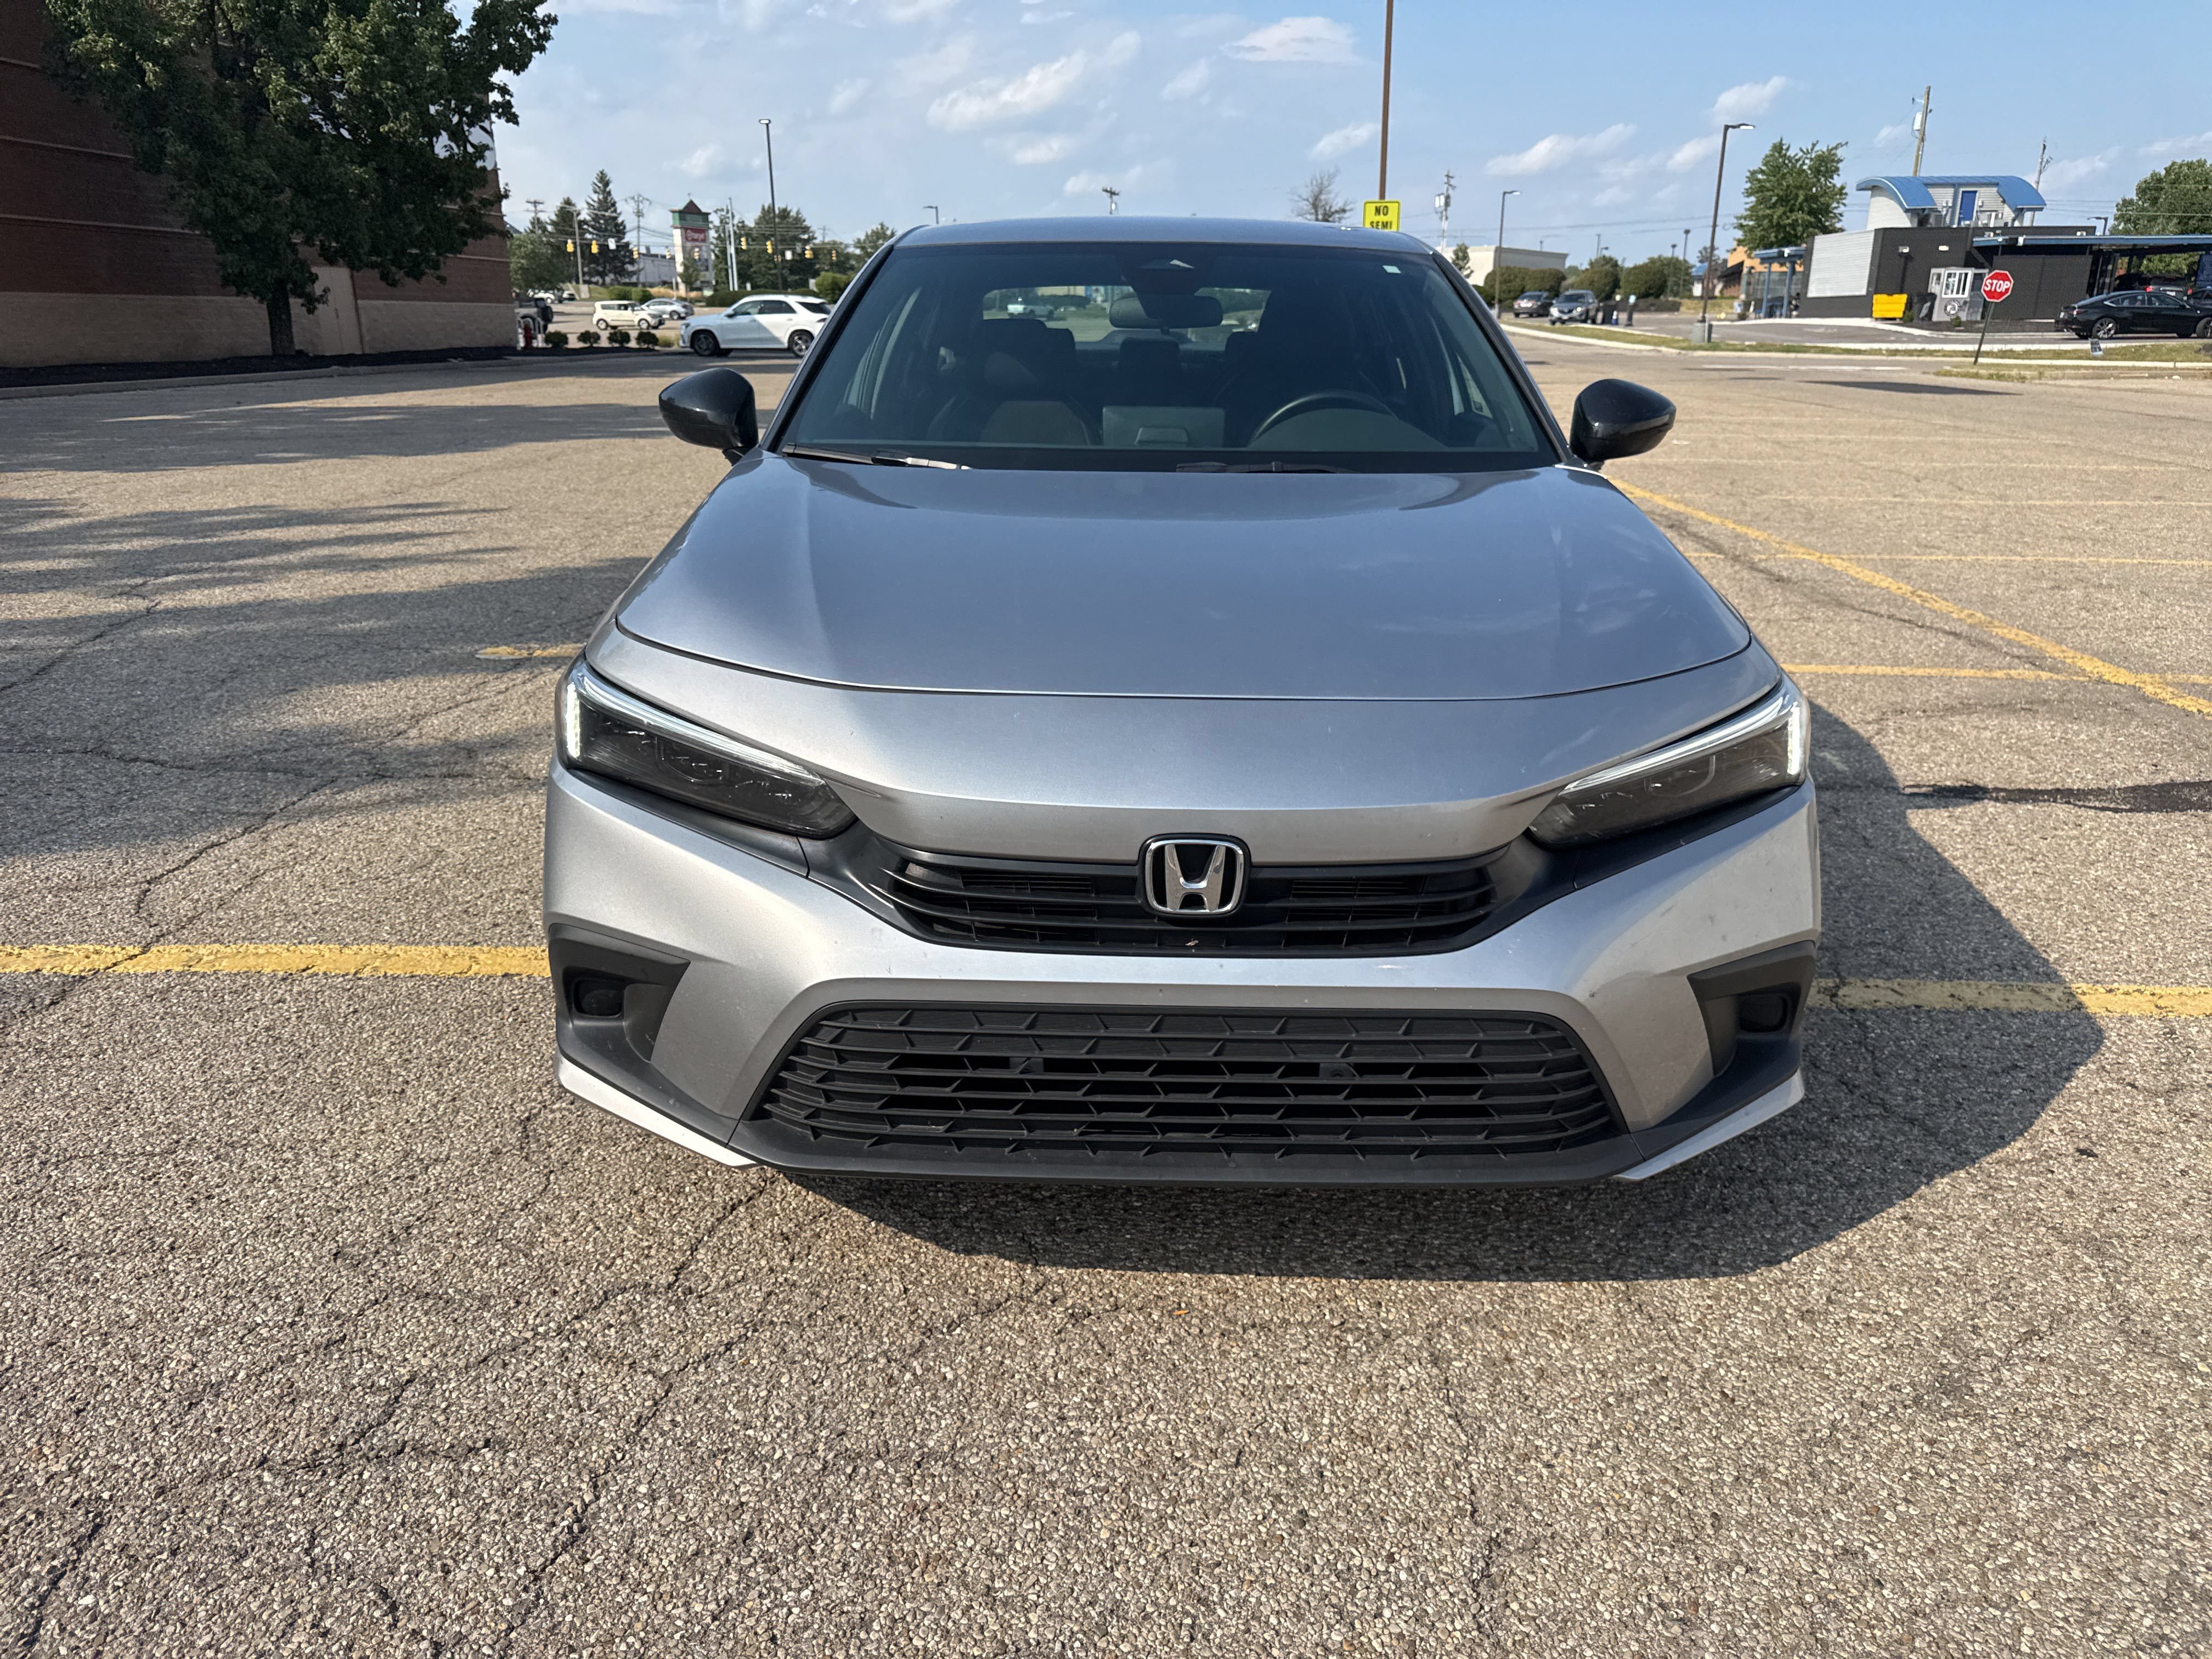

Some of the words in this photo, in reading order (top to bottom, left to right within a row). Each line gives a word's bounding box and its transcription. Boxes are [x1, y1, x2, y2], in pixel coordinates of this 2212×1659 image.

[1374, 205, 1389, 216] NO
[1370, 221, 1392, 230] SEMI
[1984, 279, 2011, 292] STOP
